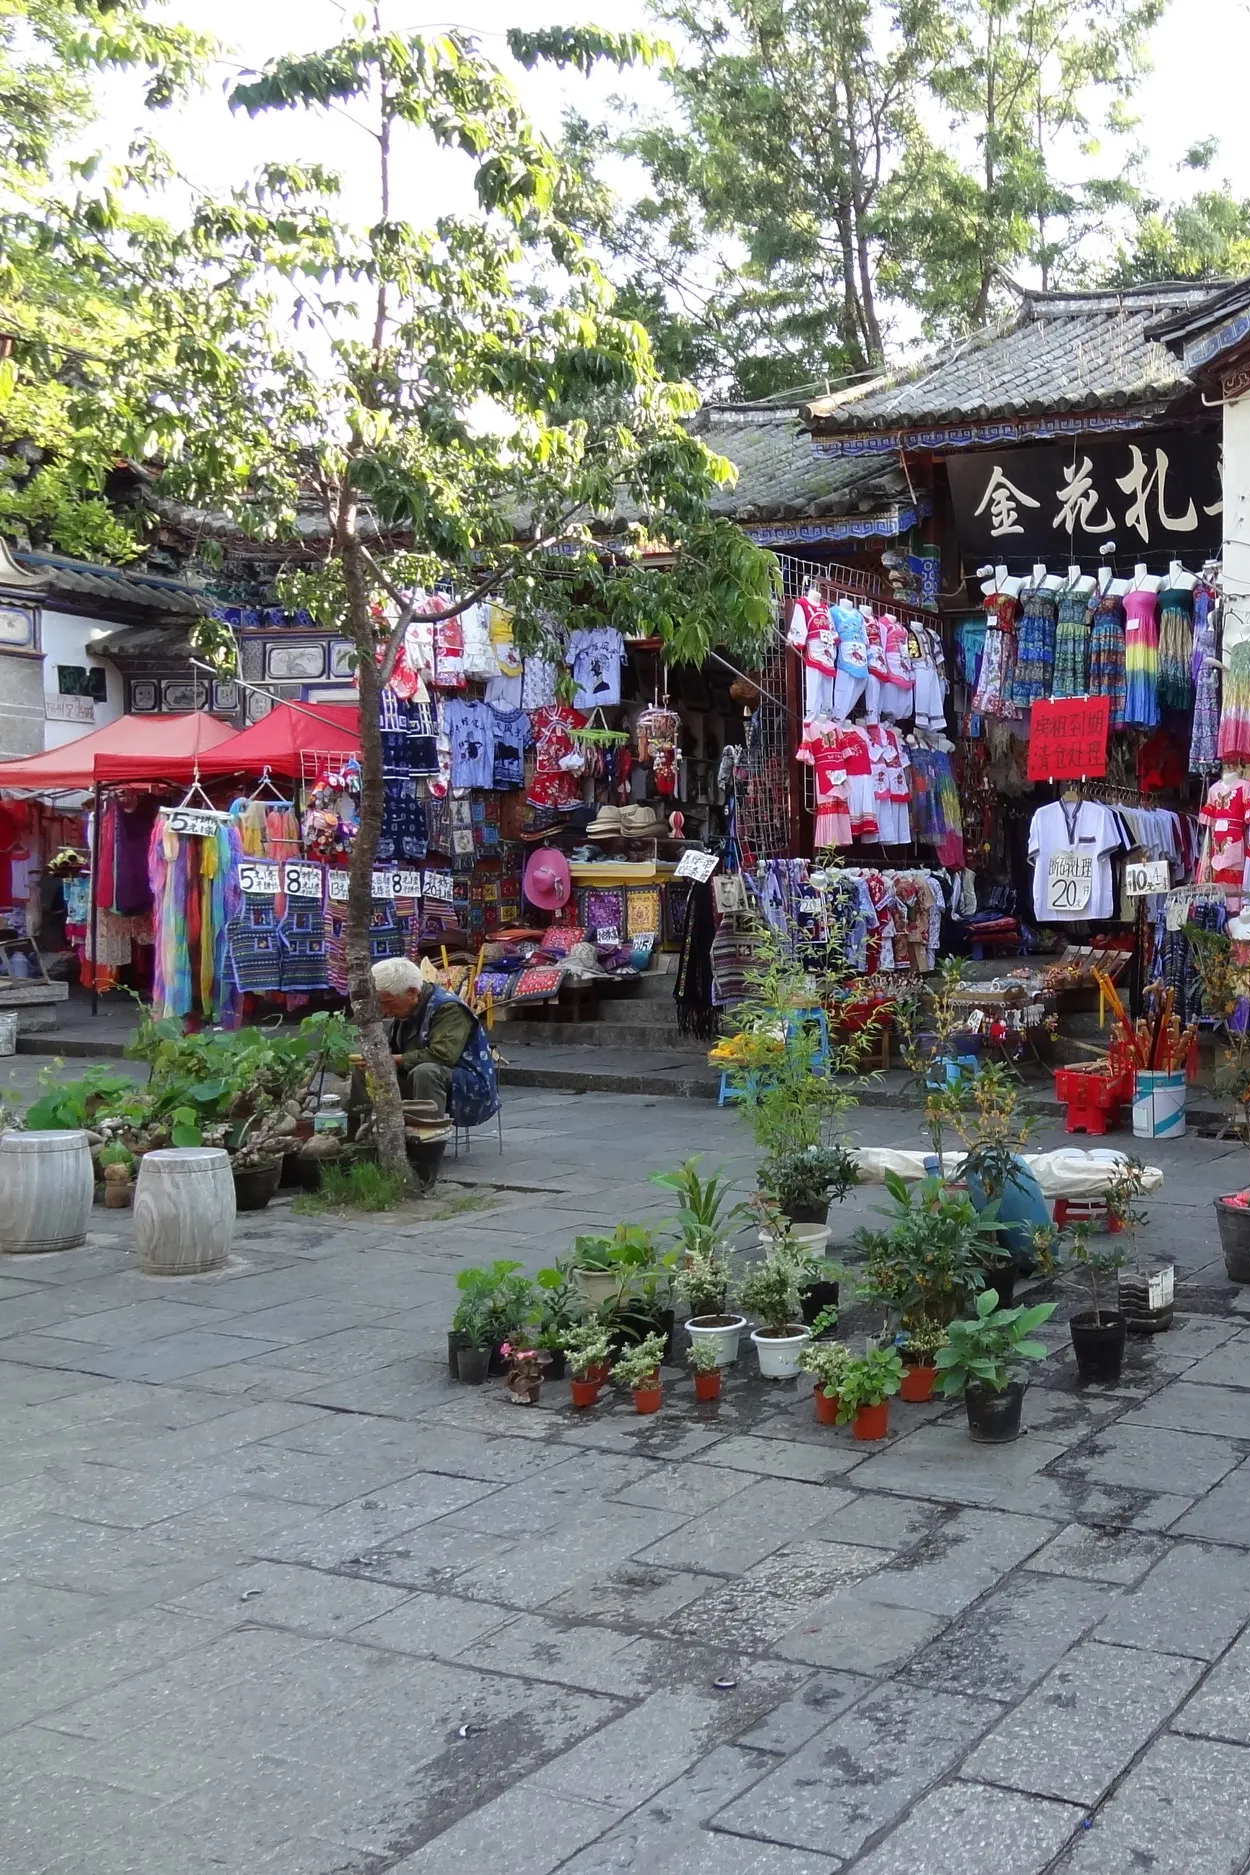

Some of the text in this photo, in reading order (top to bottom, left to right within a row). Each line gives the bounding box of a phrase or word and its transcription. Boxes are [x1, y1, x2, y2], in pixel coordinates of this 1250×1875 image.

[974, 444, 1224, 544] 金花扎
[1034, 709, 1105, 738] 房租到期
[1031, 741, 1105, 772] 清仓处理
[1048, 856, 1093, 878] 断码处理
